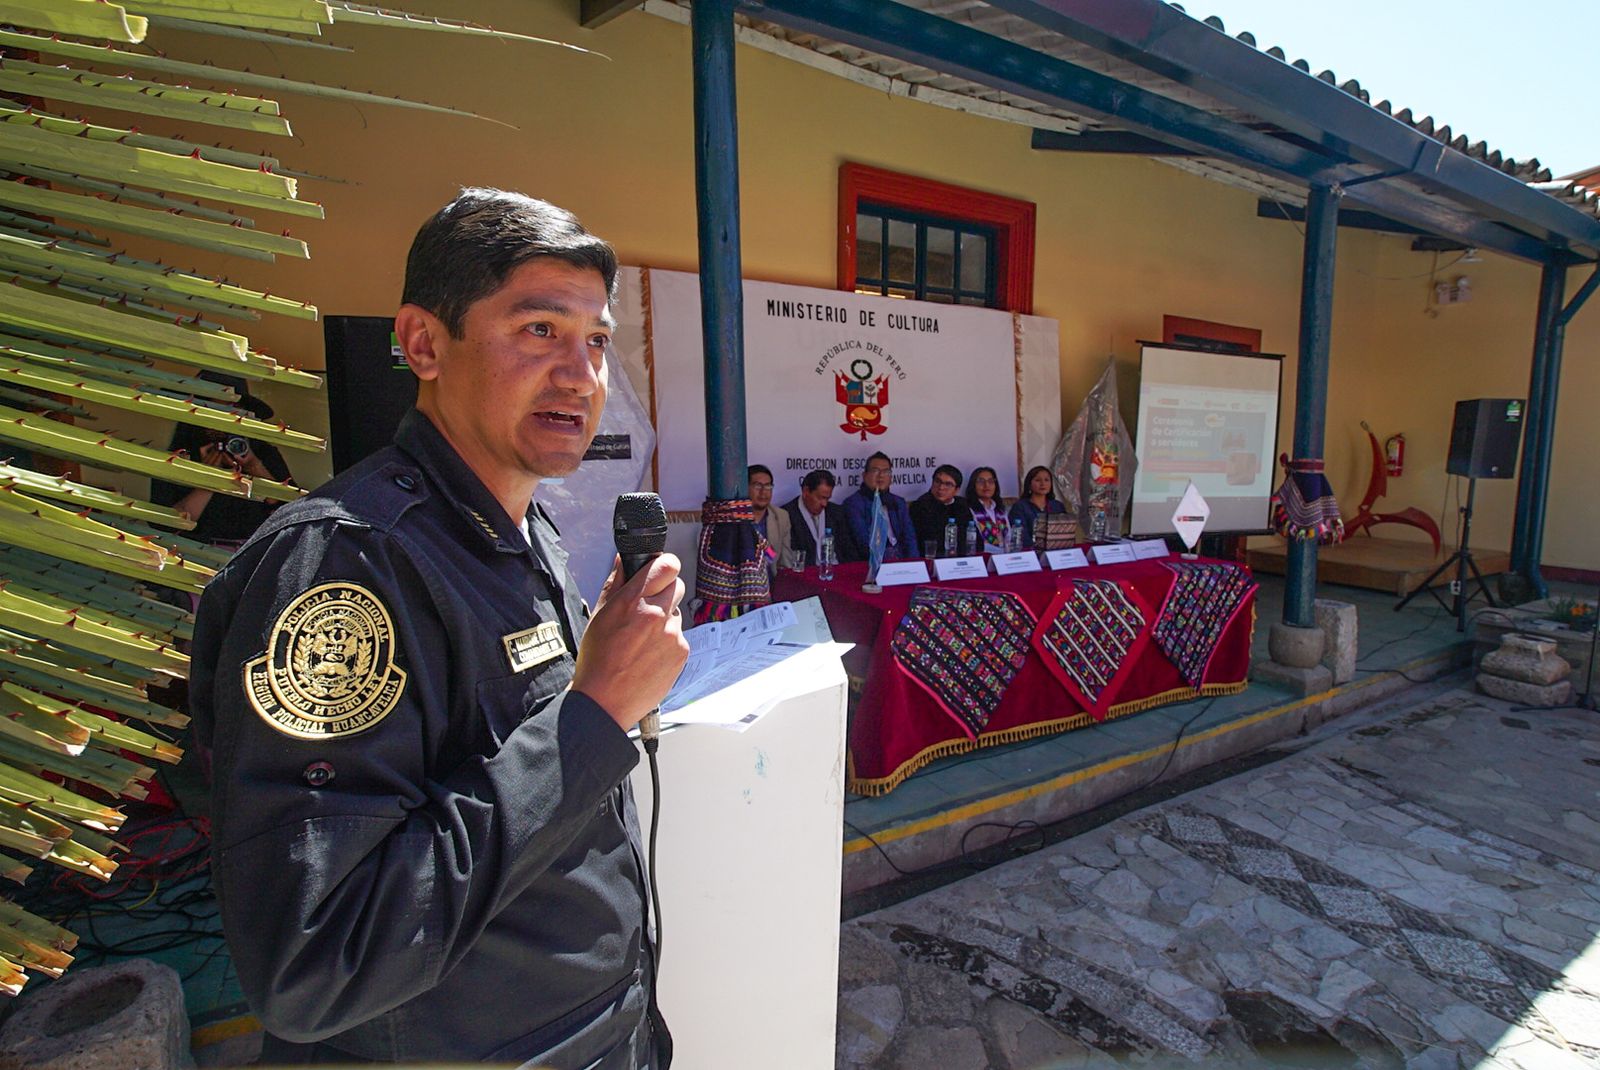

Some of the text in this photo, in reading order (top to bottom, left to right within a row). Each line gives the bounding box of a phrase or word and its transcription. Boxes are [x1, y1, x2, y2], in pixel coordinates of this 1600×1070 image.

[767, 299, 940, 333] MINISTERIO DE CULTURA
[815, 340, 907, 381] REPÚBLICA DEL PERÚ
[786, 457, 837, 470] DIRECCION
[925, 456, 937, 468] DE
[848, 475, 860, 486] DE
[893, 473, 927, 485] AVELICA
[281, 590, 389, 643] POLICIA NACIONAL
[271, 708, 325, 733] POLICIAL
[332, 679, 400, 732] HUANCAVELICA
[275, 667, 313, 710] PUEBLO
[313, 697, 362, 716] HECHO
[361, 672, 384, 699] LEY
